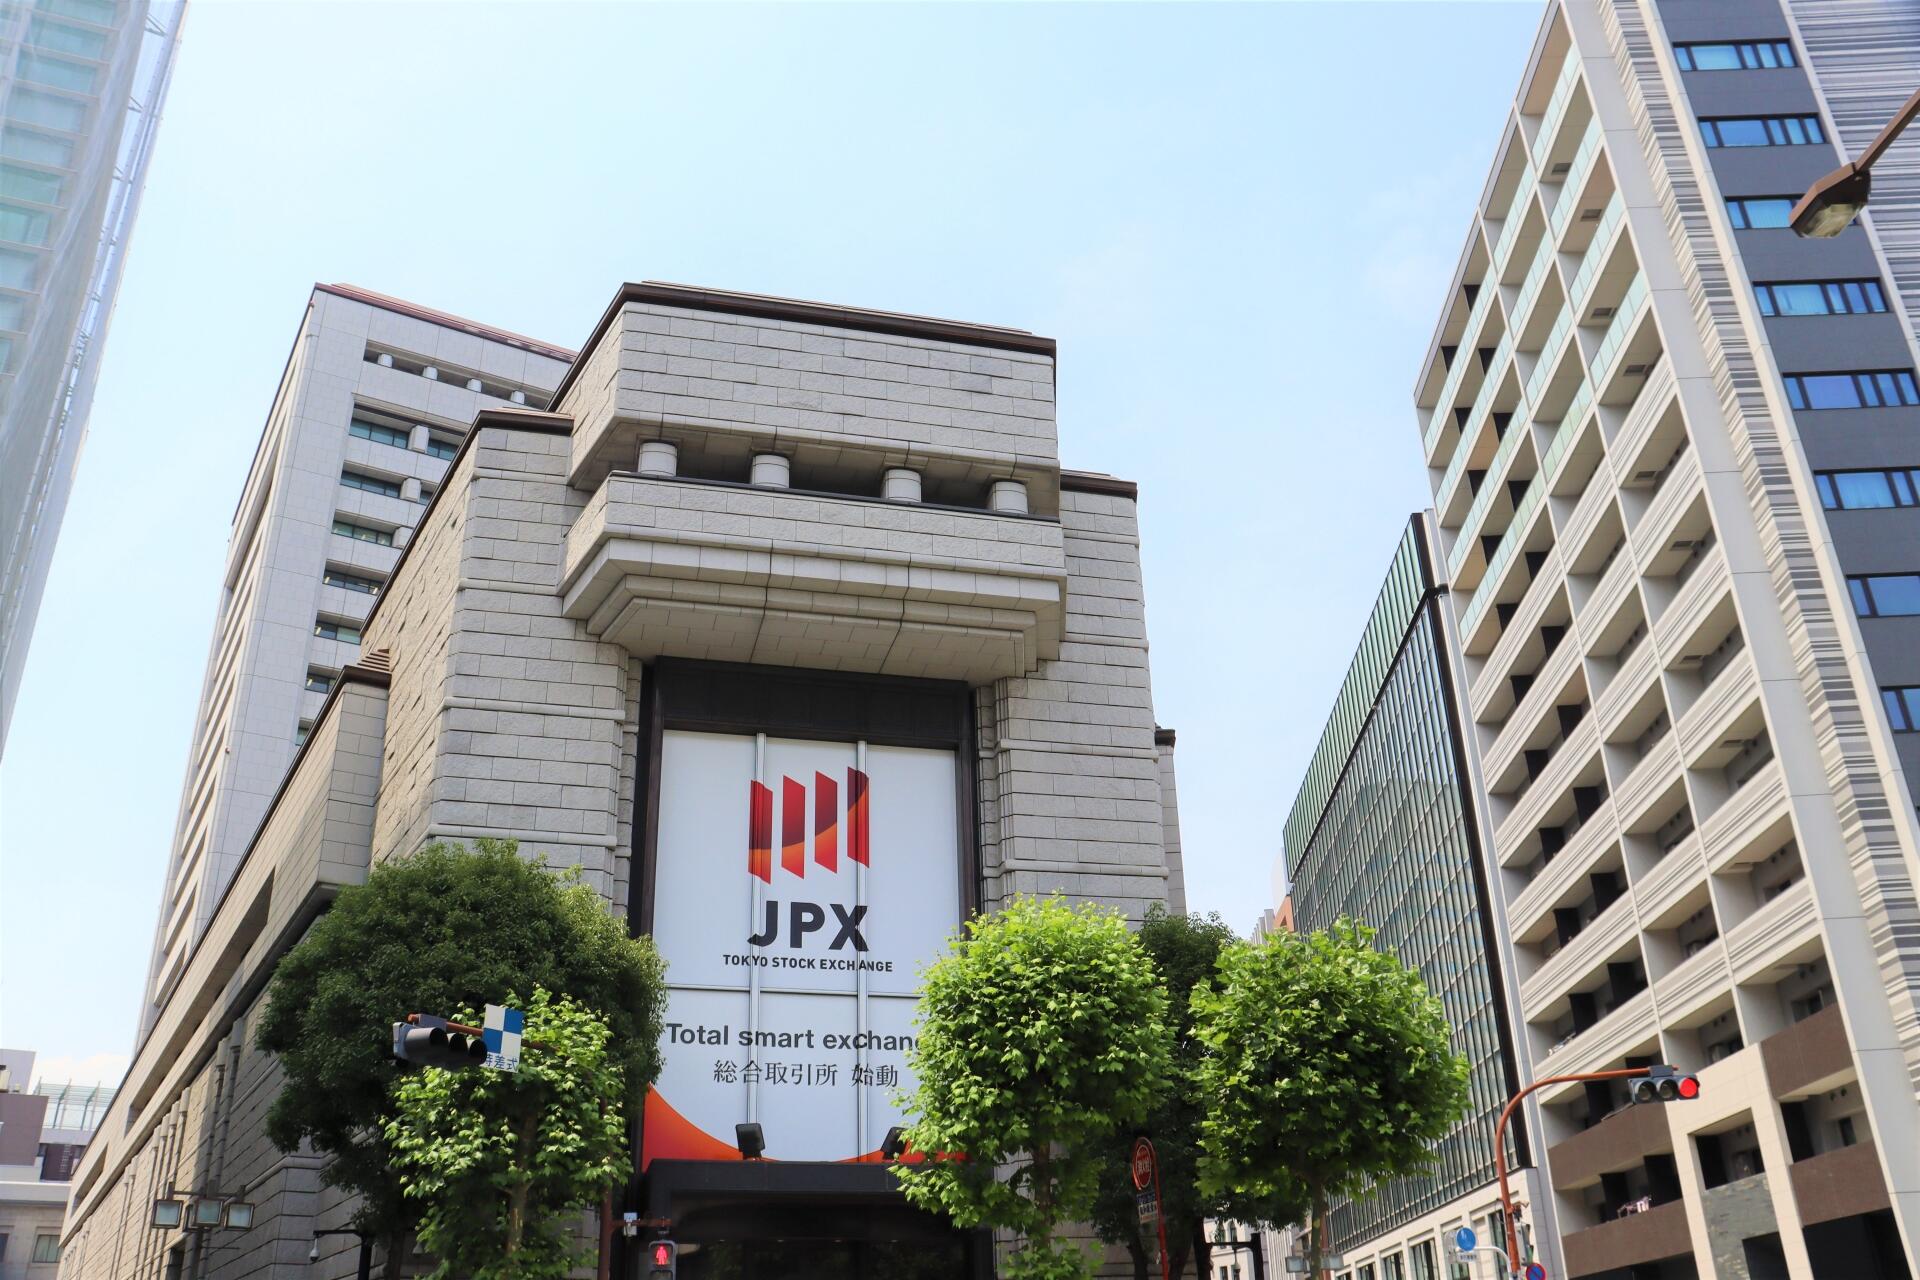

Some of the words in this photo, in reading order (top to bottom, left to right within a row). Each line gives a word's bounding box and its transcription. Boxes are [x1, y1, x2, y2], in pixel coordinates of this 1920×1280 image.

[747, 900, 870, 952] JPX
[723, 954, 768, 967] TOKYO
[772, 957, 816, 970] STOCK
[820, 959, 893, 972] EXCHANGE
[666, 1023, 729, 1045] Total
[738, 1029, 814, 1049] smart
[713, 1059, 838, 1087] 総合取引所
[851, 1063, 898, 1088] 始動
